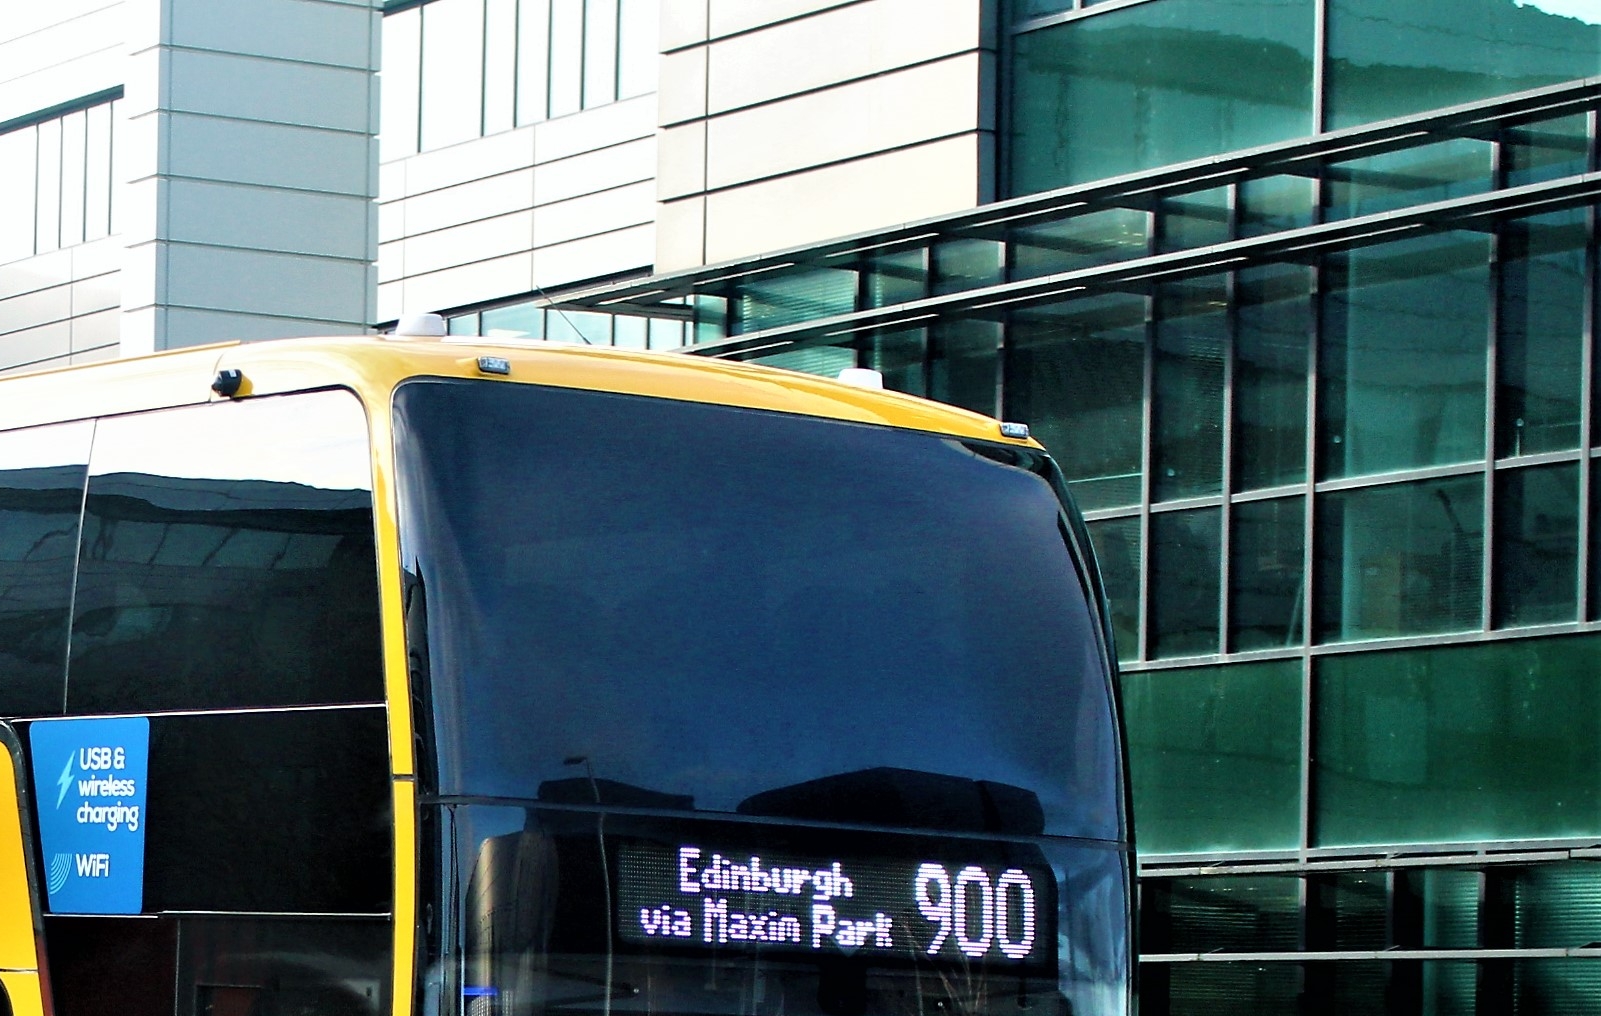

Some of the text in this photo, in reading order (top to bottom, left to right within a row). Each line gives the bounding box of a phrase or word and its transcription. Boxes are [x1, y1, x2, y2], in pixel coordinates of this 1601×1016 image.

[79, 747, 125, 770] USB &
[78, 774, 135, 797] wireless
[76, 801, 139, 832] charging
[75, 853, 110, 878] WiFi
[678, 847, 854, 900] Edinburgh
[639, 897, 894, 949] via Maxim Park
[915, 863, 1035, 959] 900
